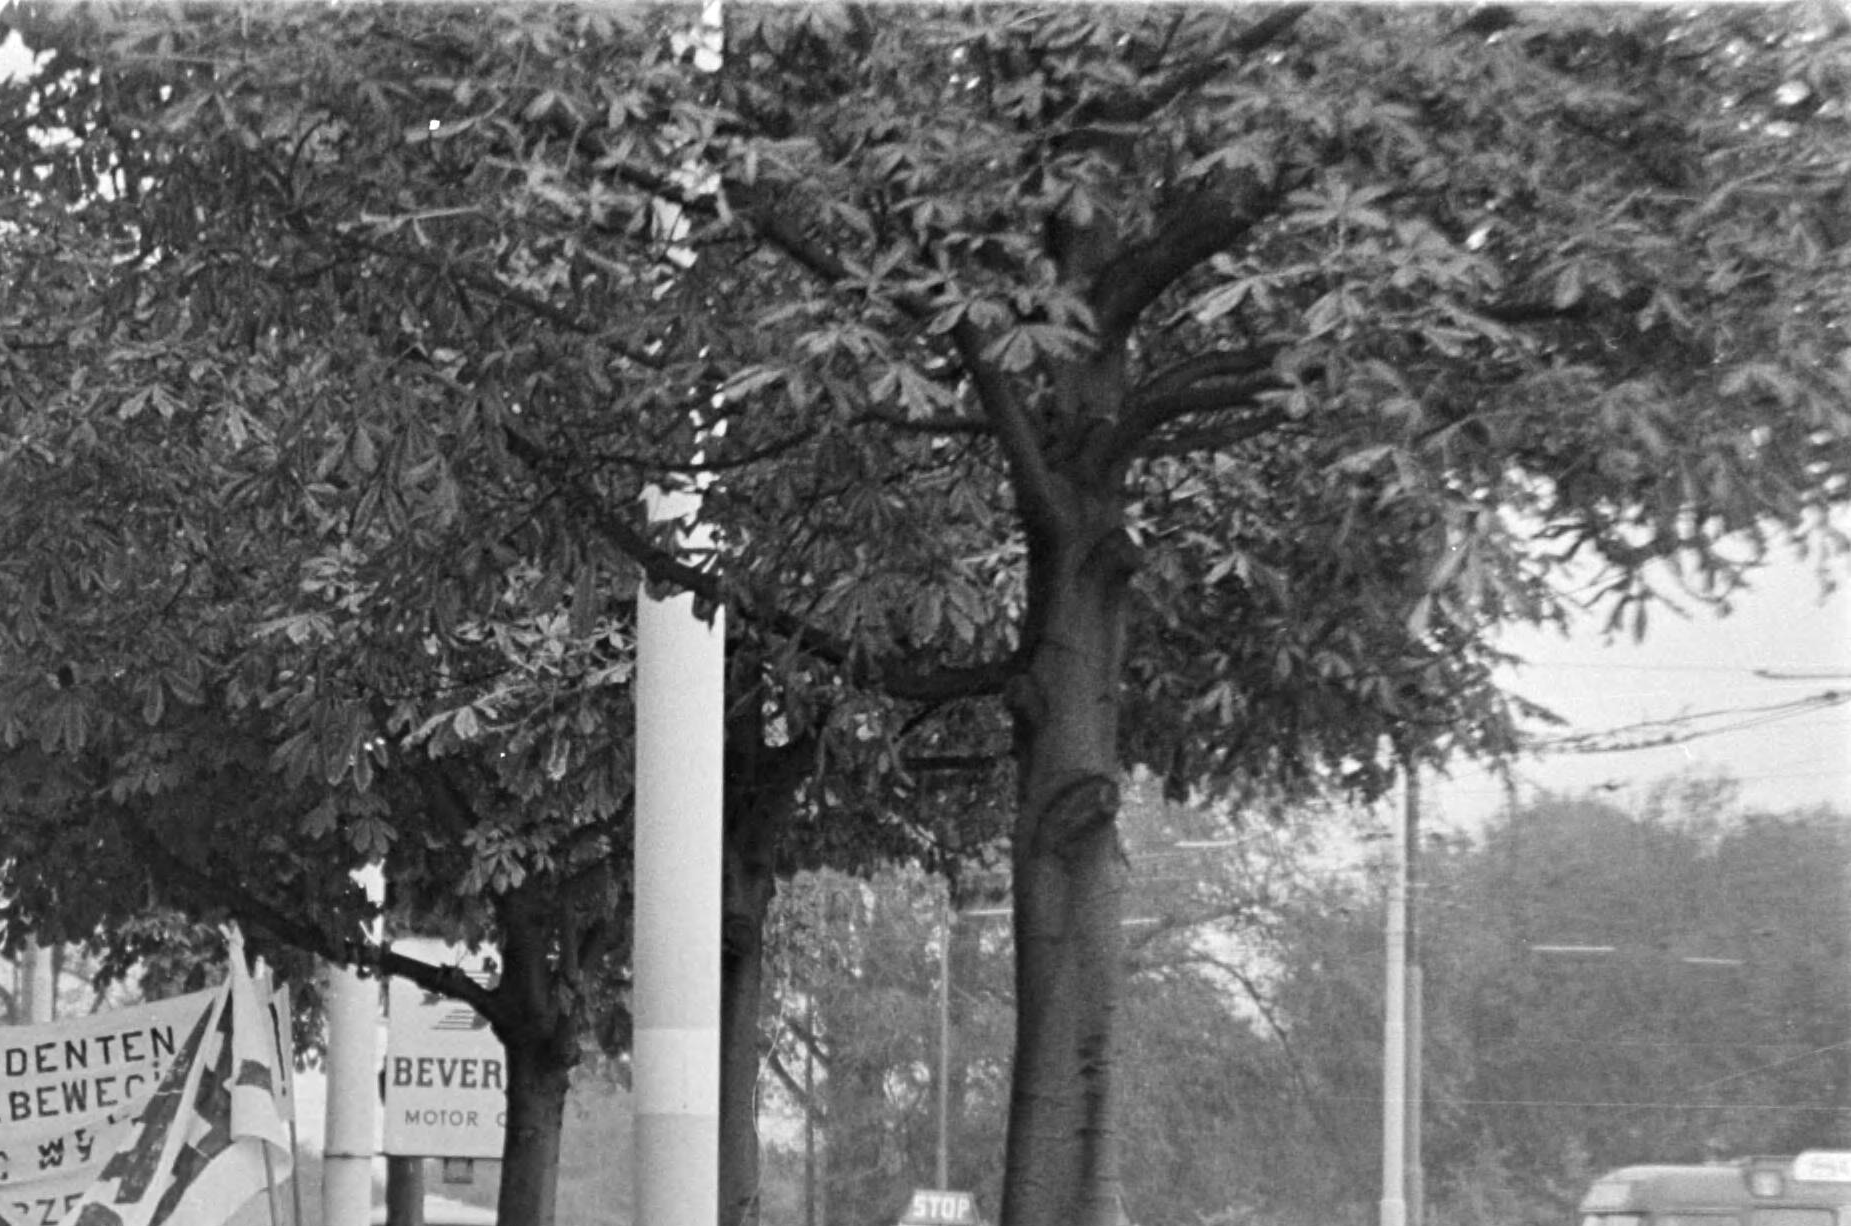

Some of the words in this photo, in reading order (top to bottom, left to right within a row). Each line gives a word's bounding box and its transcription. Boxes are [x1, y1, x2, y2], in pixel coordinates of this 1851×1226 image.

[392, 1056, 503, 1091] BEVER
[404, 1109, 479, 1128] MOTOR
[912, 1194, 971, 1220] STOP
